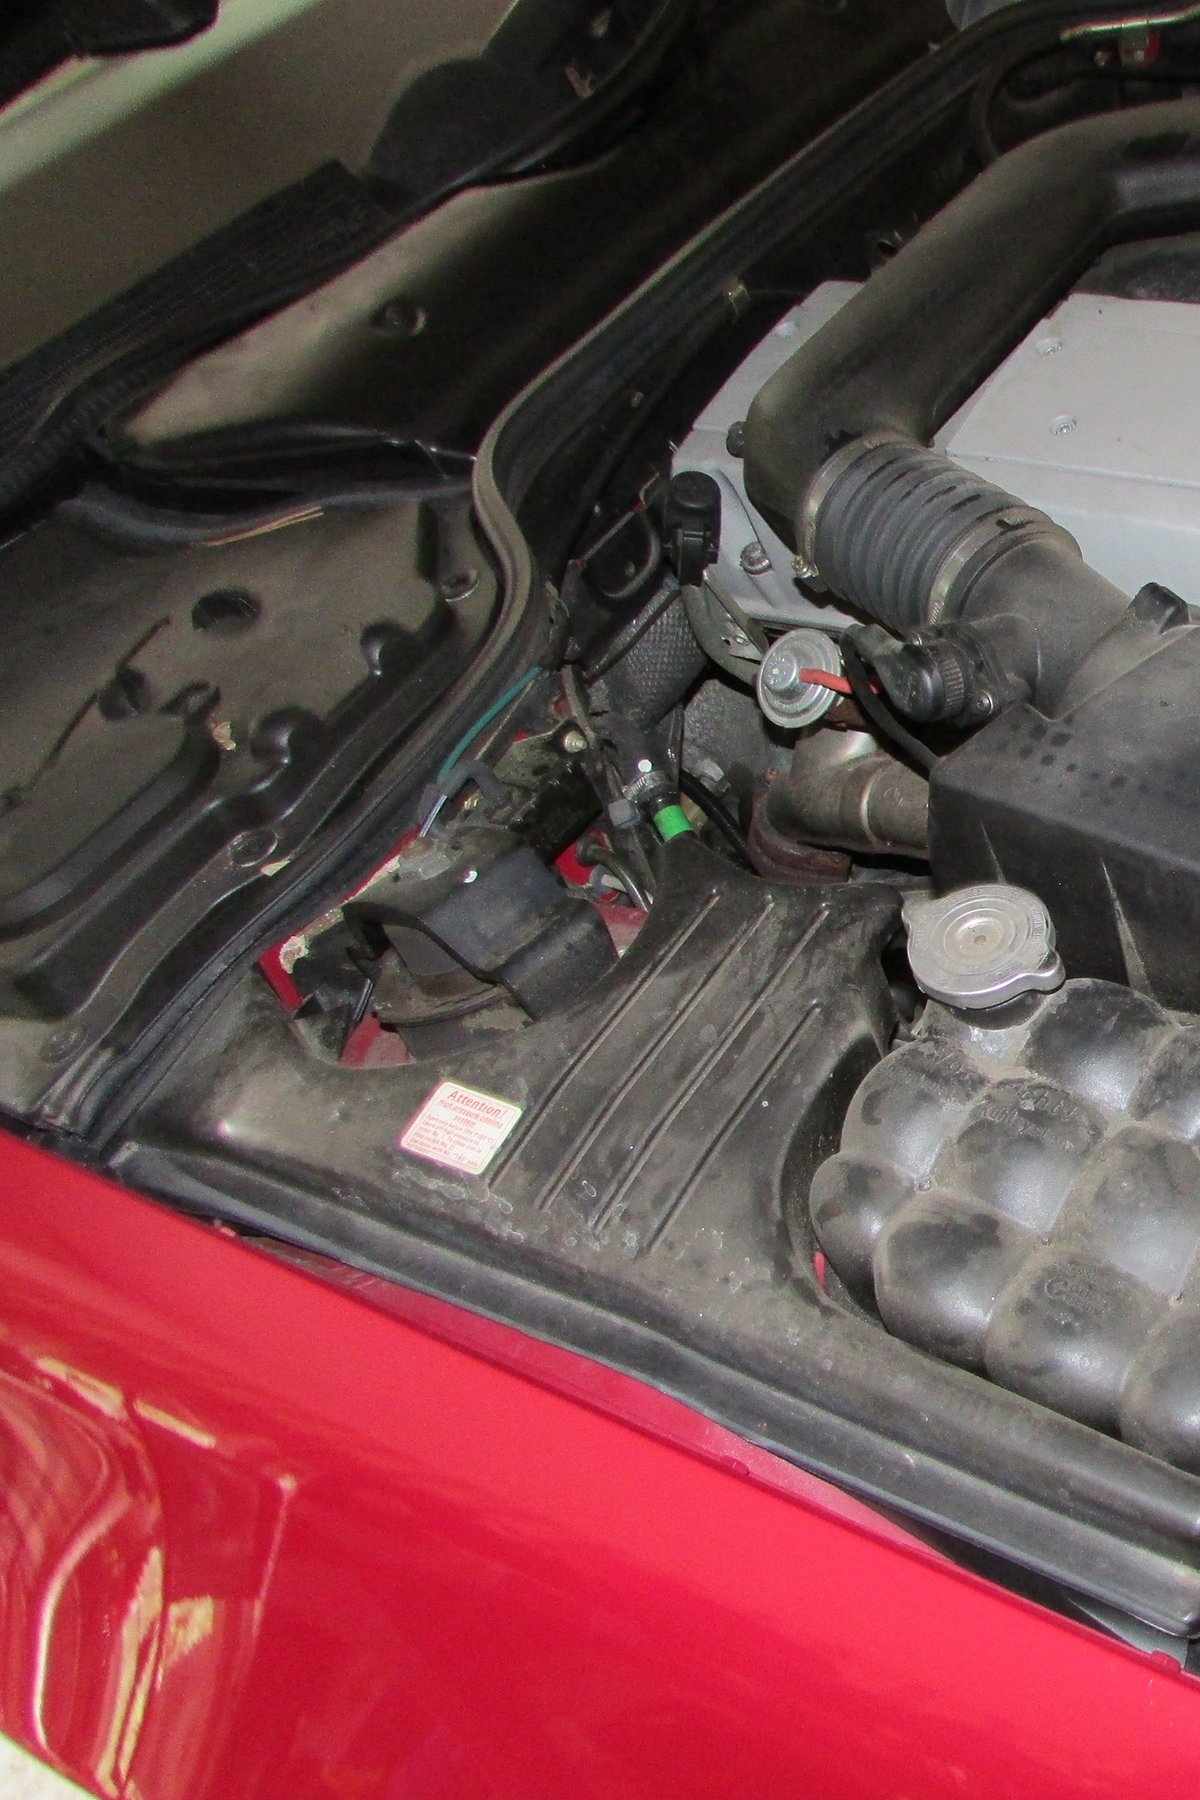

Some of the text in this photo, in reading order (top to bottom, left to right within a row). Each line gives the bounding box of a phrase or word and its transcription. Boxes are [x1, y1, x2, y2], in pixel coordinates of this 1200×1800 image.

[438, 1099, 504, 1128] High pressure cooling
[447, 1091, 508, 1119] Attention!
[453, 1115, 478, 1127] system
